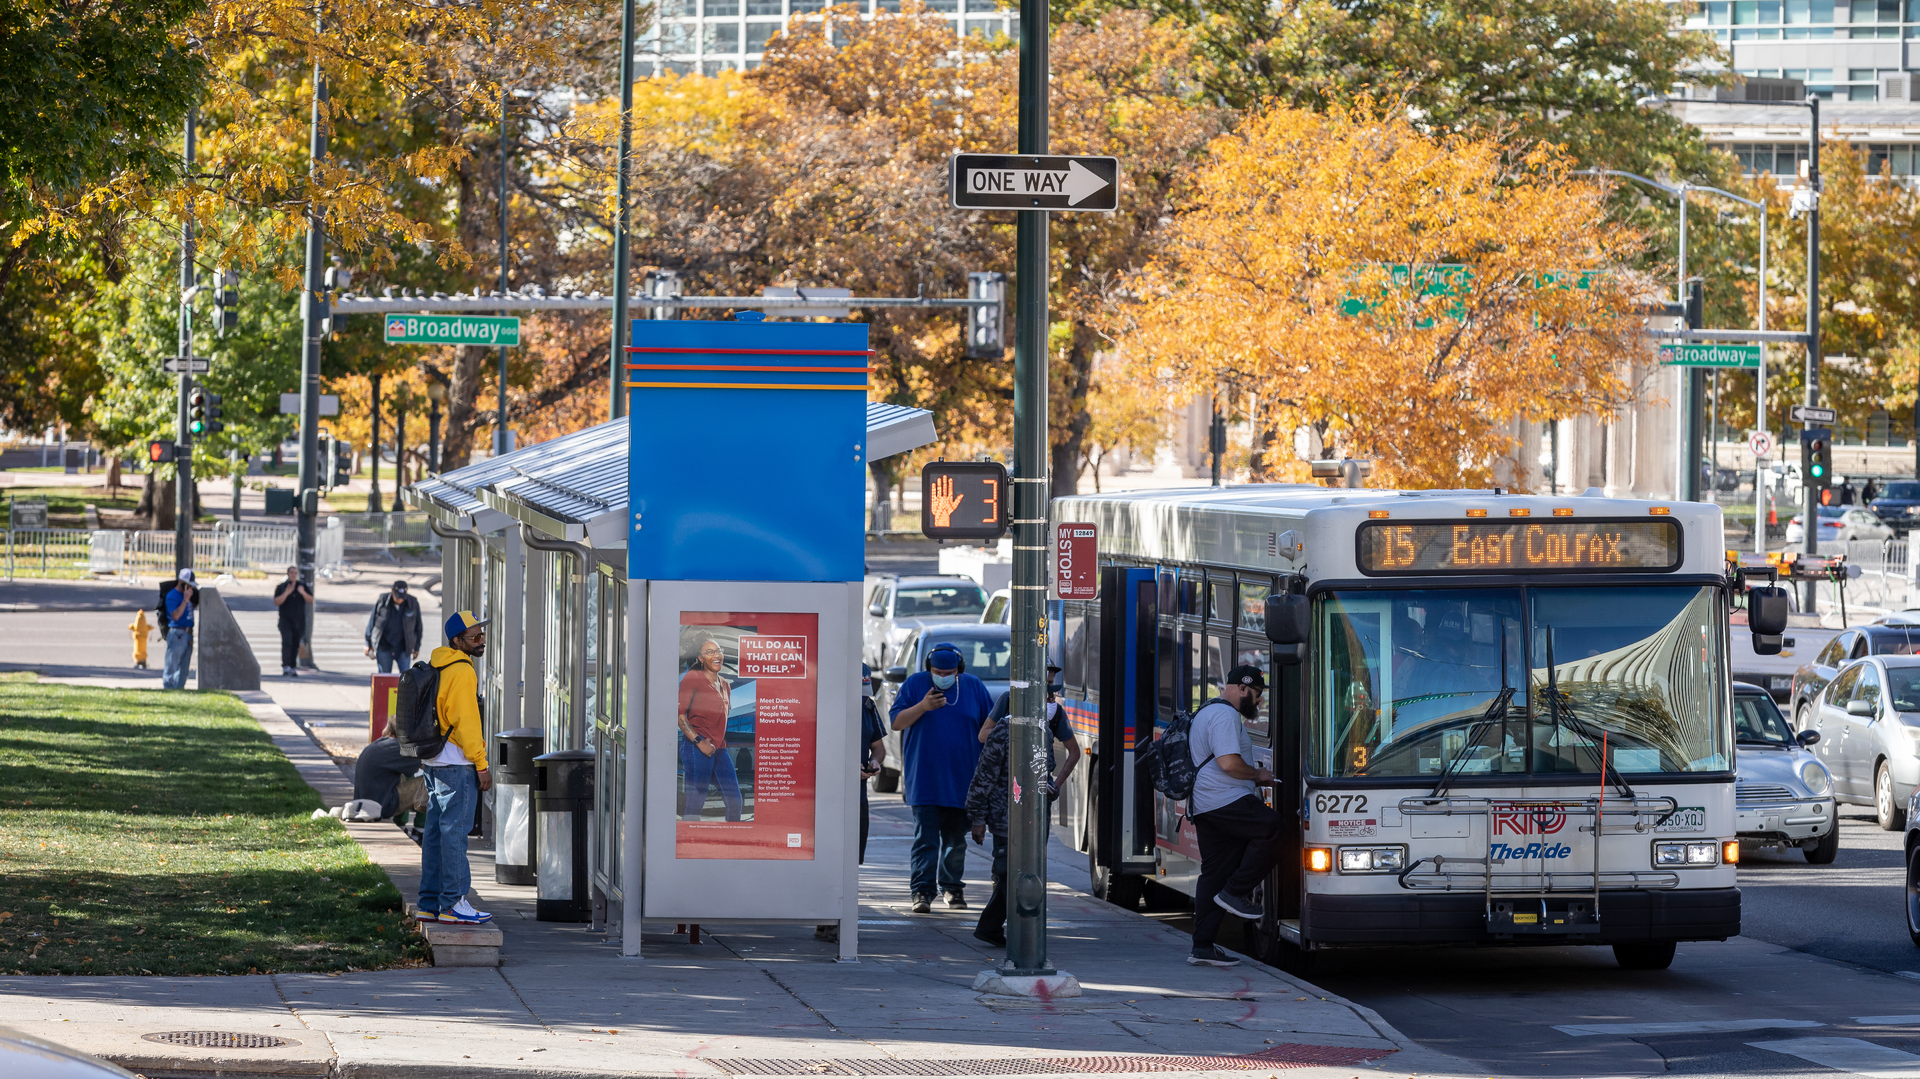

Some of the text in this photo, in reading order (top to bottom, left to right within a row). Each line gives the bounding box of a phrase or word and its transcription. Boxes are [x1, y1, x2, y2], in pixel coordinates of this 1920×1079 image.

[973, 171, 1068, 192] ONE WAY
[407, 318, 500, 343] Broadway
[1675, 347, 1747, 366] Broadway
[982, 479, 997, 523] 3
[1059, 528, 1072, 539] MY
[1382, 524, 1621, 566] 15 EAST COLFAX
[1059, 540, 1072, 579] STOP
[766, 641, 781, 649] DO
[783, 641, 802, 649] ALL
[746, 653, 802, 661] THAT I CAN
[746, 665, 760, 673] TO
[1353, 746, 1367, 767] 3
[1315, 794, 1368, 813] 6272
[1490, 843, 1571, 859] TheRide
